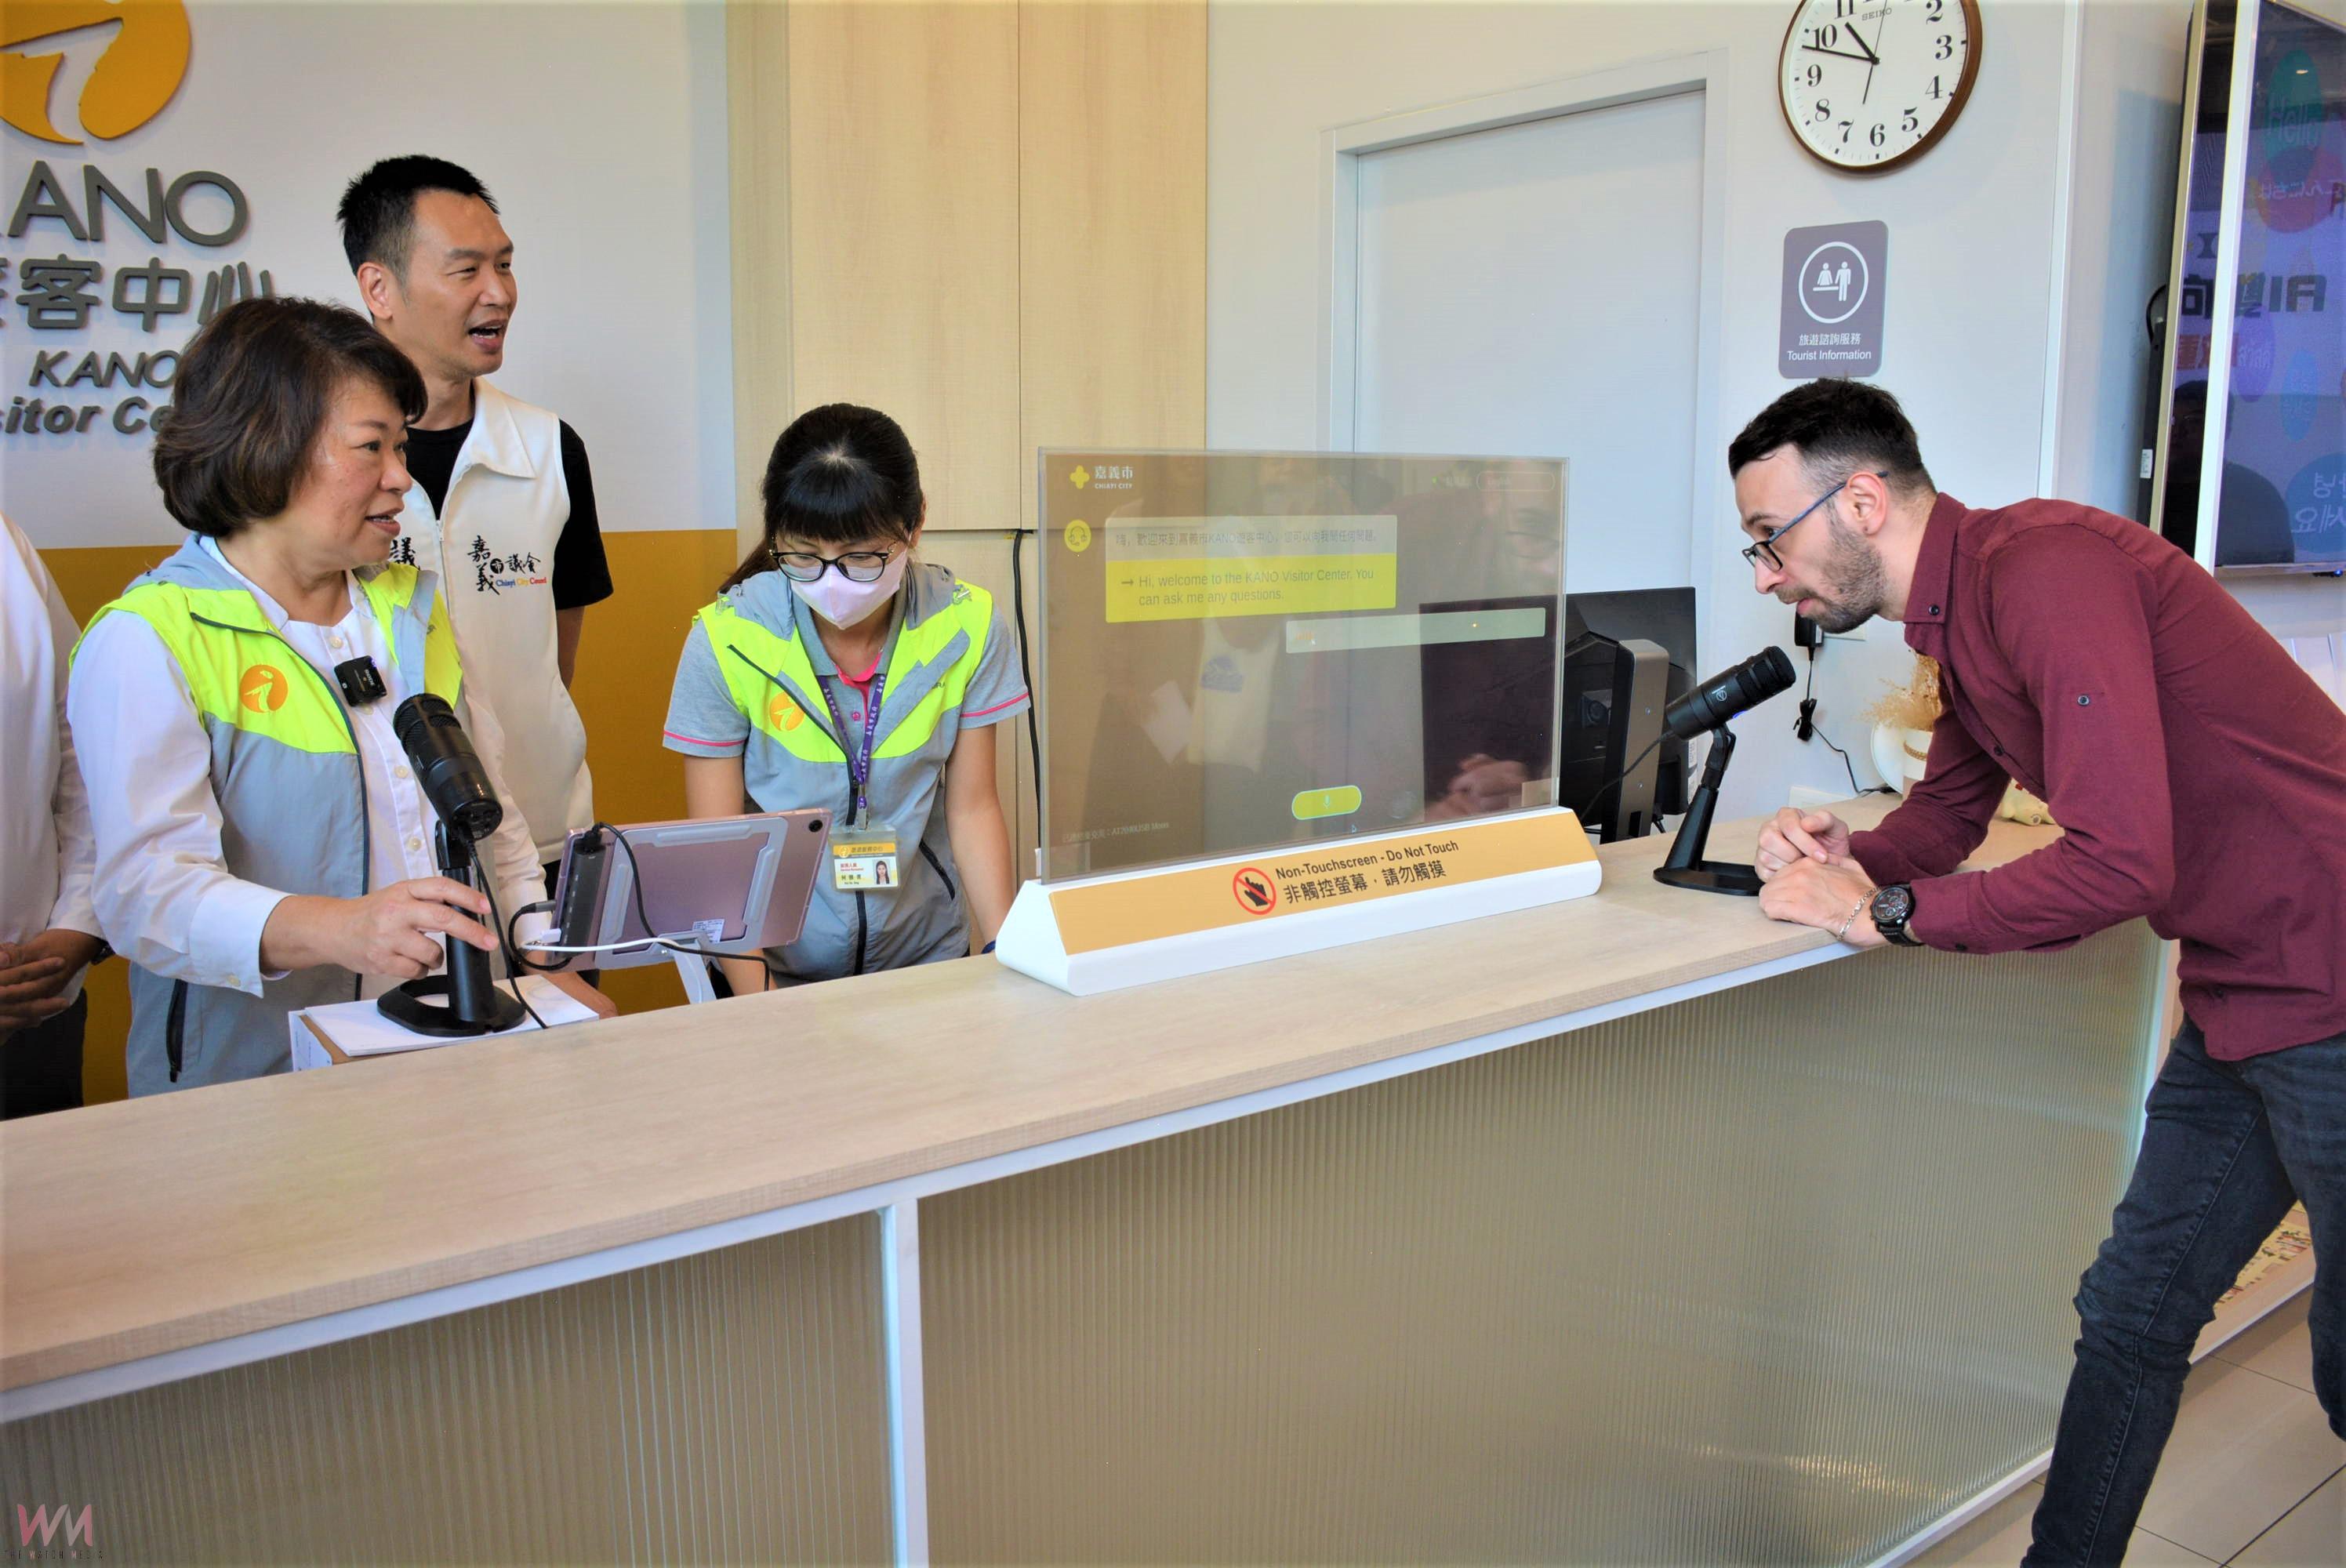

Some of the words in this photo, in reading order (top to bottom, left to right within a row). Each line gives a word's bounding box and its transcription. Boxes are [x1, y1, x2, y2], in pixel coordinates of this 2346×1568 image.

[1861, 8, 1892, 21] SEIKO
[1926, 0, 1943, 24] 2
[1813, 24, 1837, 49] 10
[1935, 34, 1952, 60] 3
[1807, 64, 1821, 87] 9
[1925, 75, 1943, 100] 4
[1815, 99, 1831, 122] 8
[1901, 107, 1919, 132] 5
[1838, 119, 1854, 143] 7
[1869, 124, 1885, 147] 6
[0, 160, 248, 247] ANO
[1798, 332, 1861, 346] 旅遊諮詢服務
[1787, 350, 1818, 361] Tourist
[1819, 349, 1872, 360] Information
[28, 350, 181, 388] KANO
[0, 396, 102, 434] itor
[1095, 465, 1133, 479] 嘉義市
[1139, 575, 1154, 589] Hi,
[1158, 574, 1208, 587] welcome
[1211, 573, 1222, 585] to
[1226, 572, 1242, 584] the
[1245, 572, 1279, 583] KANO
[1282, 569, 1313, 582] Visitor
[1356, 568, 1374, 579] You
[1139, 595, 1160, 606] can
[1163, 593, 1183, 604] ask
[1186, 593, 1204, 604] me
[1208, 593, 1226, 605] any
[1230, 589, 1284, 604] questions.
[1276, 855, 1378, 880] Non-Touchscreen
[1386, 850, 1403, 862] Do
[1405, 846, 1425, 858] Not
[1427, 840, 1458, 855] Touch
